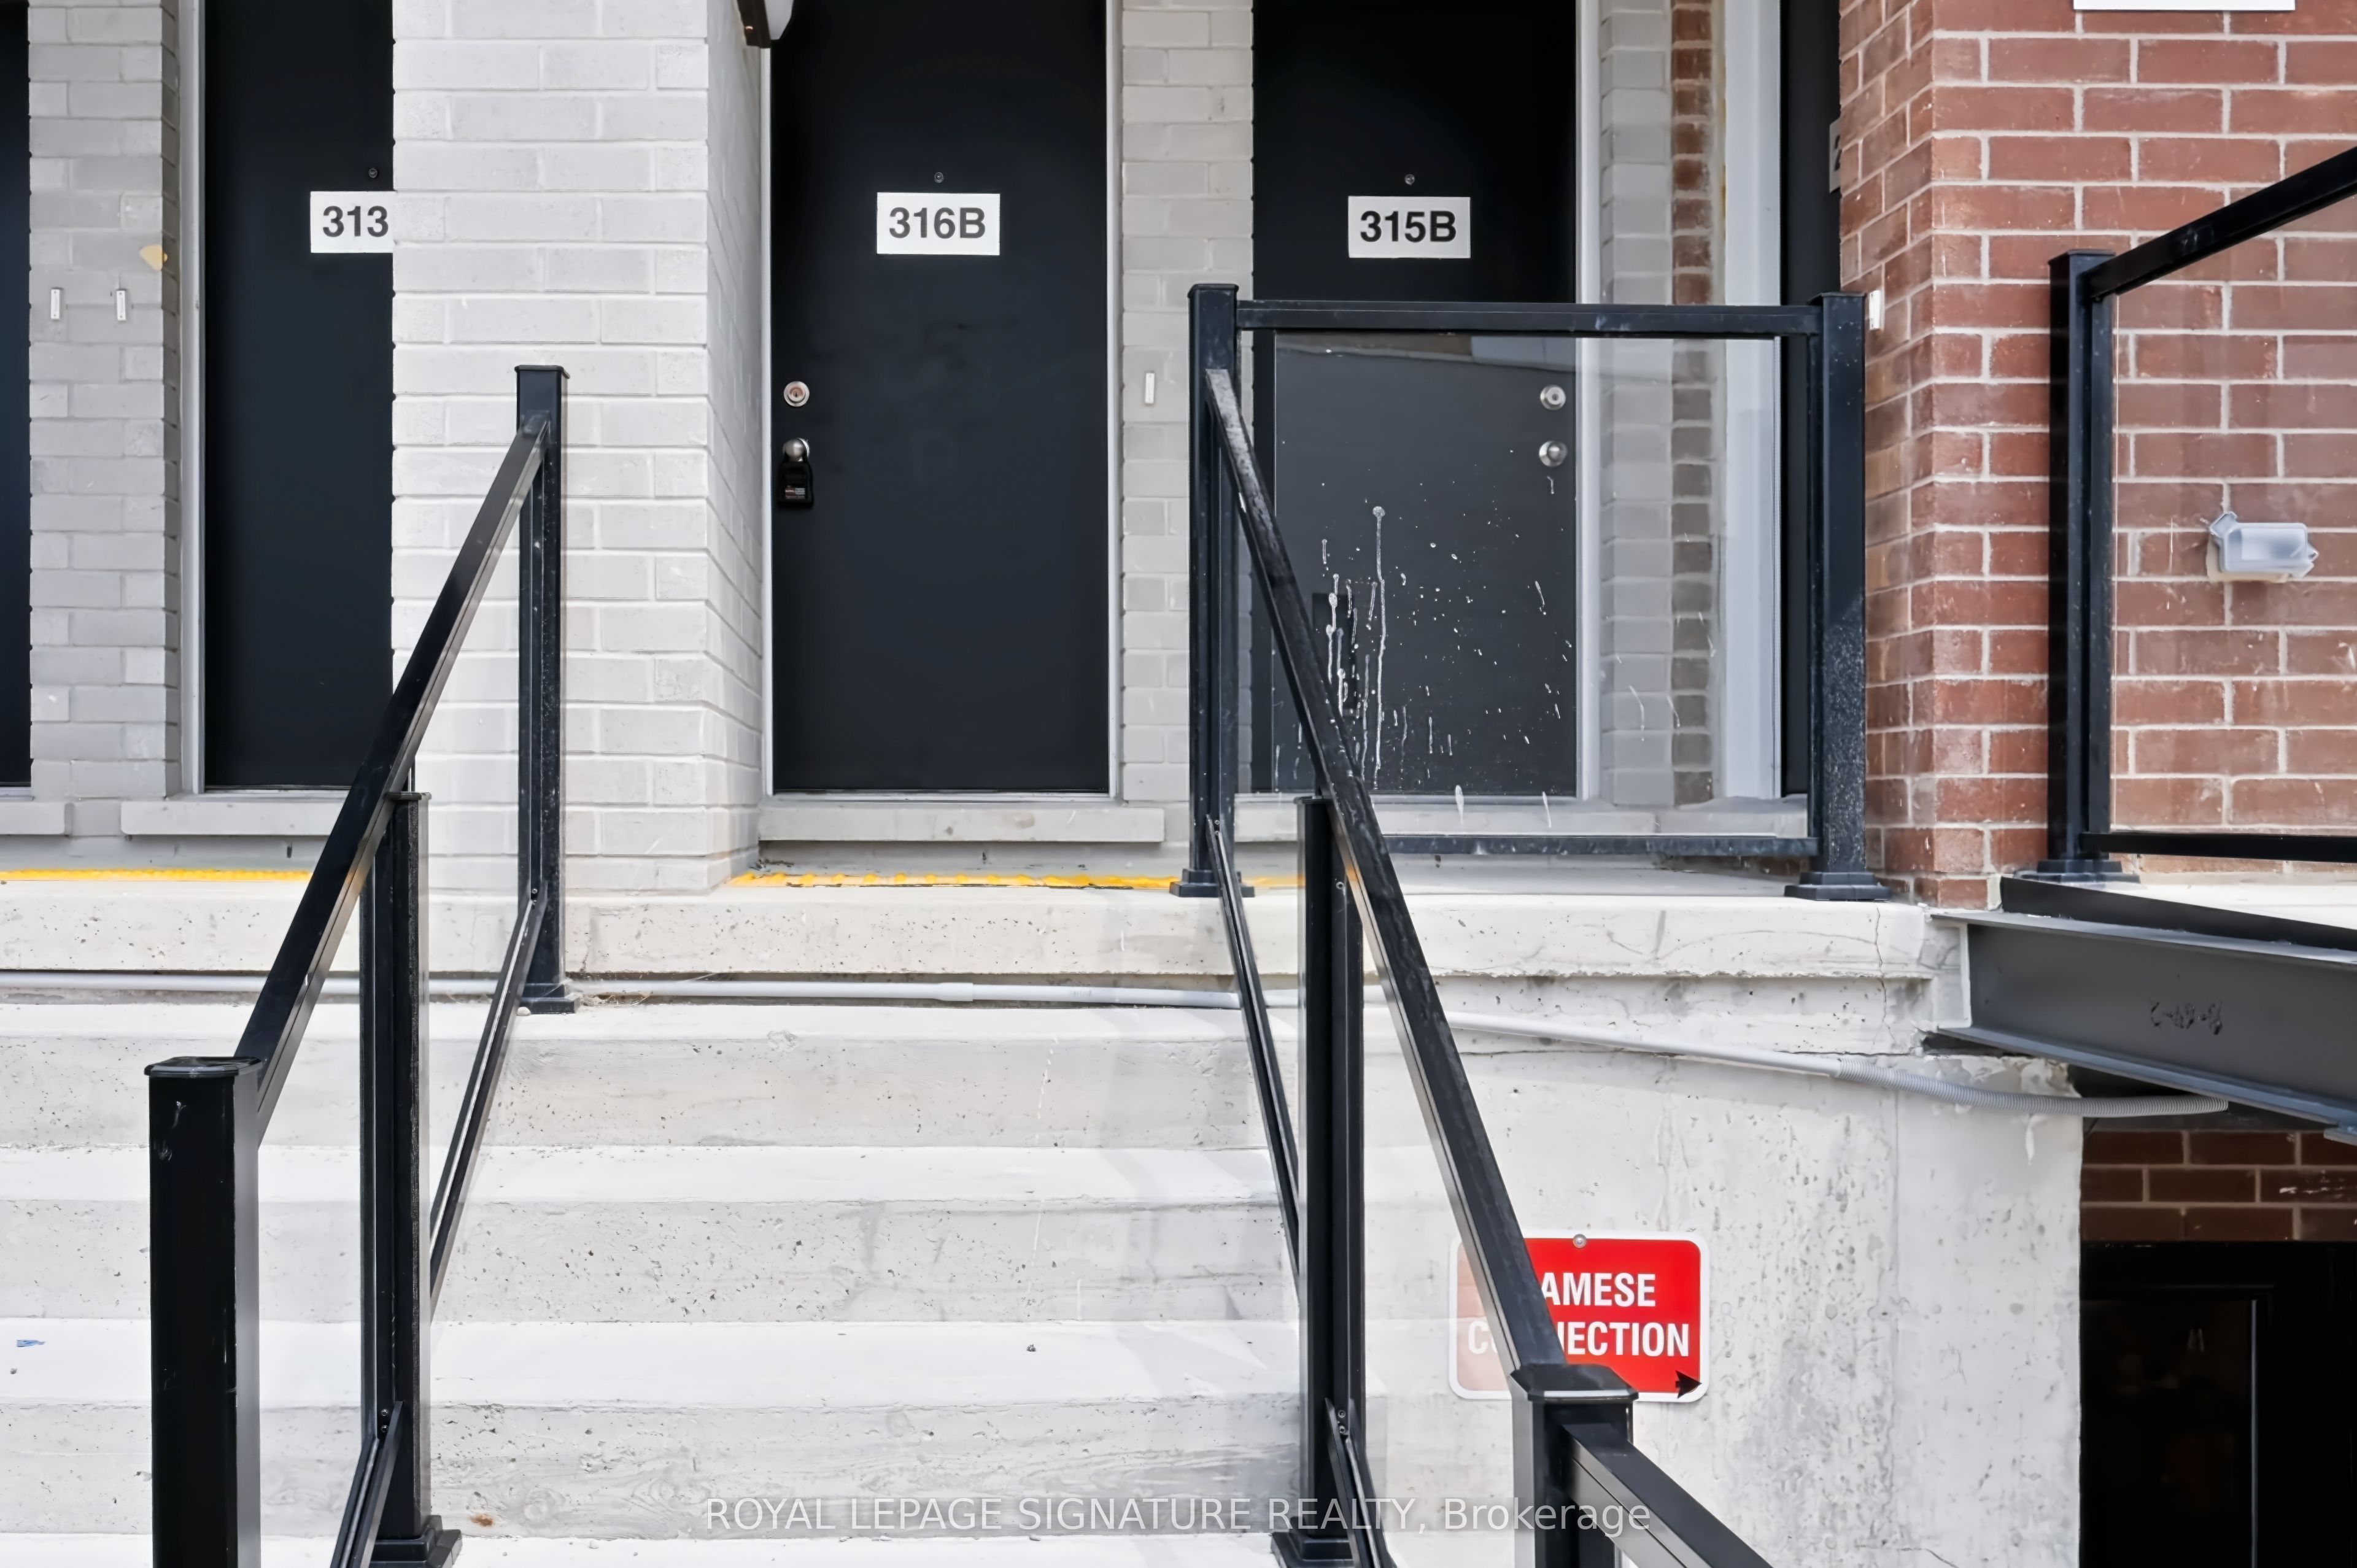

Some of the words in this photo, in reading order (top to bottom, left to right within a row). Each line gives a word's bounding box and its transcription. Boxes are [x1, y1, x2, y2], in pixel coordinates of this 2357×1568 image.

[322, 206, 389, 238] 313
[889, 207, 986, 239] 316B
[1360, 210, 1457, 242] 315B
[1541, 1272, 1656, 1307] AMESE
[1468, 1321, 1690, 1357] CECTION
